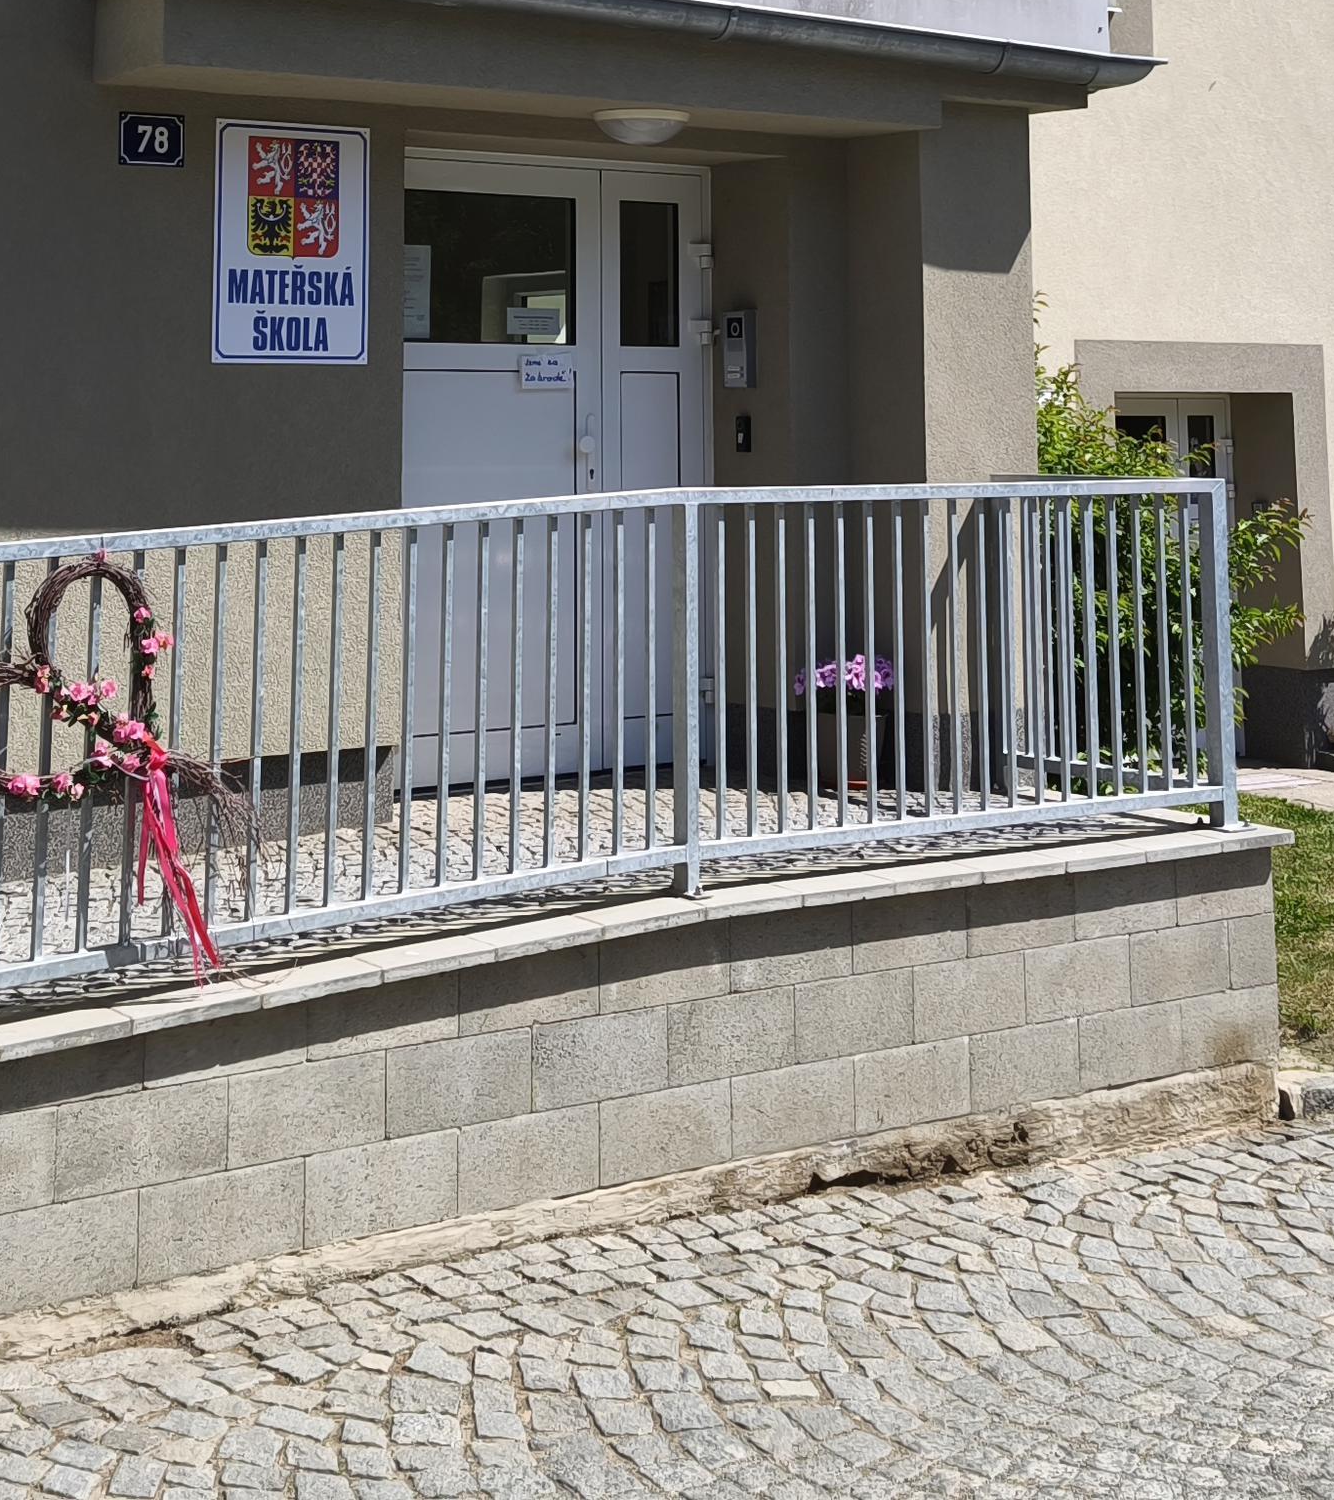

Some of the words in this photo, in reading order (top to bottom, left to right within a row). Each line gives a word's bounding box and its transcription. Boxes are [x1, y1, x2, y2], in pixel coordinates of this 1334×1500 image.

[137, 125, 169, 154] 78
[227, 264, 355, 306] MATEŘSKÁ
[252, 310, 329, 352] ŠKOLA
